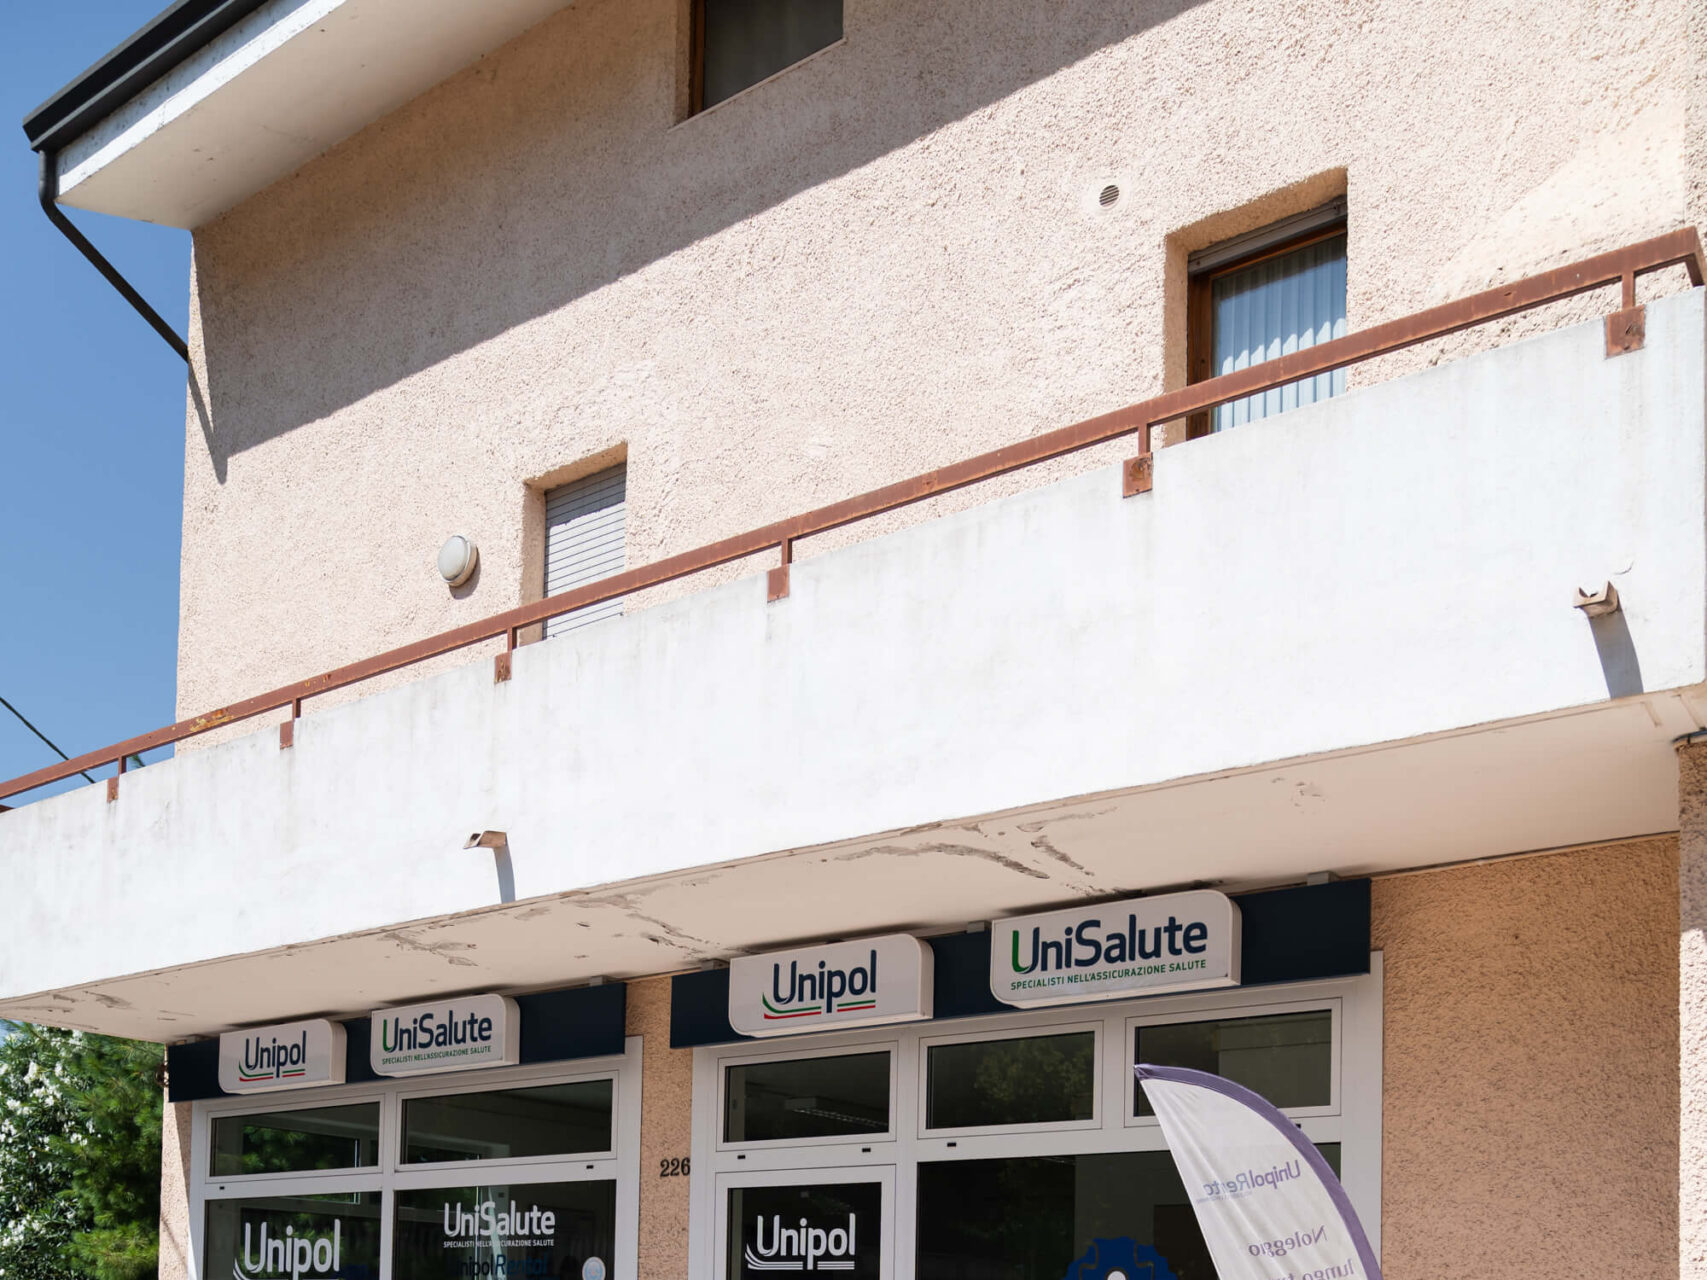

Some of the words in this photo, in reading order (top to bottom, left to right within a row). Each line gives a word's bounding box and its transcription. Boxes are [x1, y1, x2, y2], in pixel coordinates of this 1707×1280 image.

[1011, 914, 1208, 974] UniSalute
[772, 949, 877, 1013] Unipol
[1010, 976, 1065, 991] SPECIALISTI
[1067, 965, 1166, 984] NELL'ASSICURAZIONE
[1169, 959, 1207, 973] SALUTE
[382, 1010, 493, 1053] UniSalute
[244, 1030, 307, 1078] Unipol
[381, 1055, 413, 1065] SPECIALISTI
[470, 1045, 491, 1055] SALUTE
[660, 1157, 691, 1177] 226
[443, 1200, 556, 1237] UniSalute
[443, 1240, 475, 1249] SPECIALISTI
[532, 1239, 555, 1247] SALUTE
[756, 1213, 856, 1270] Unipol
